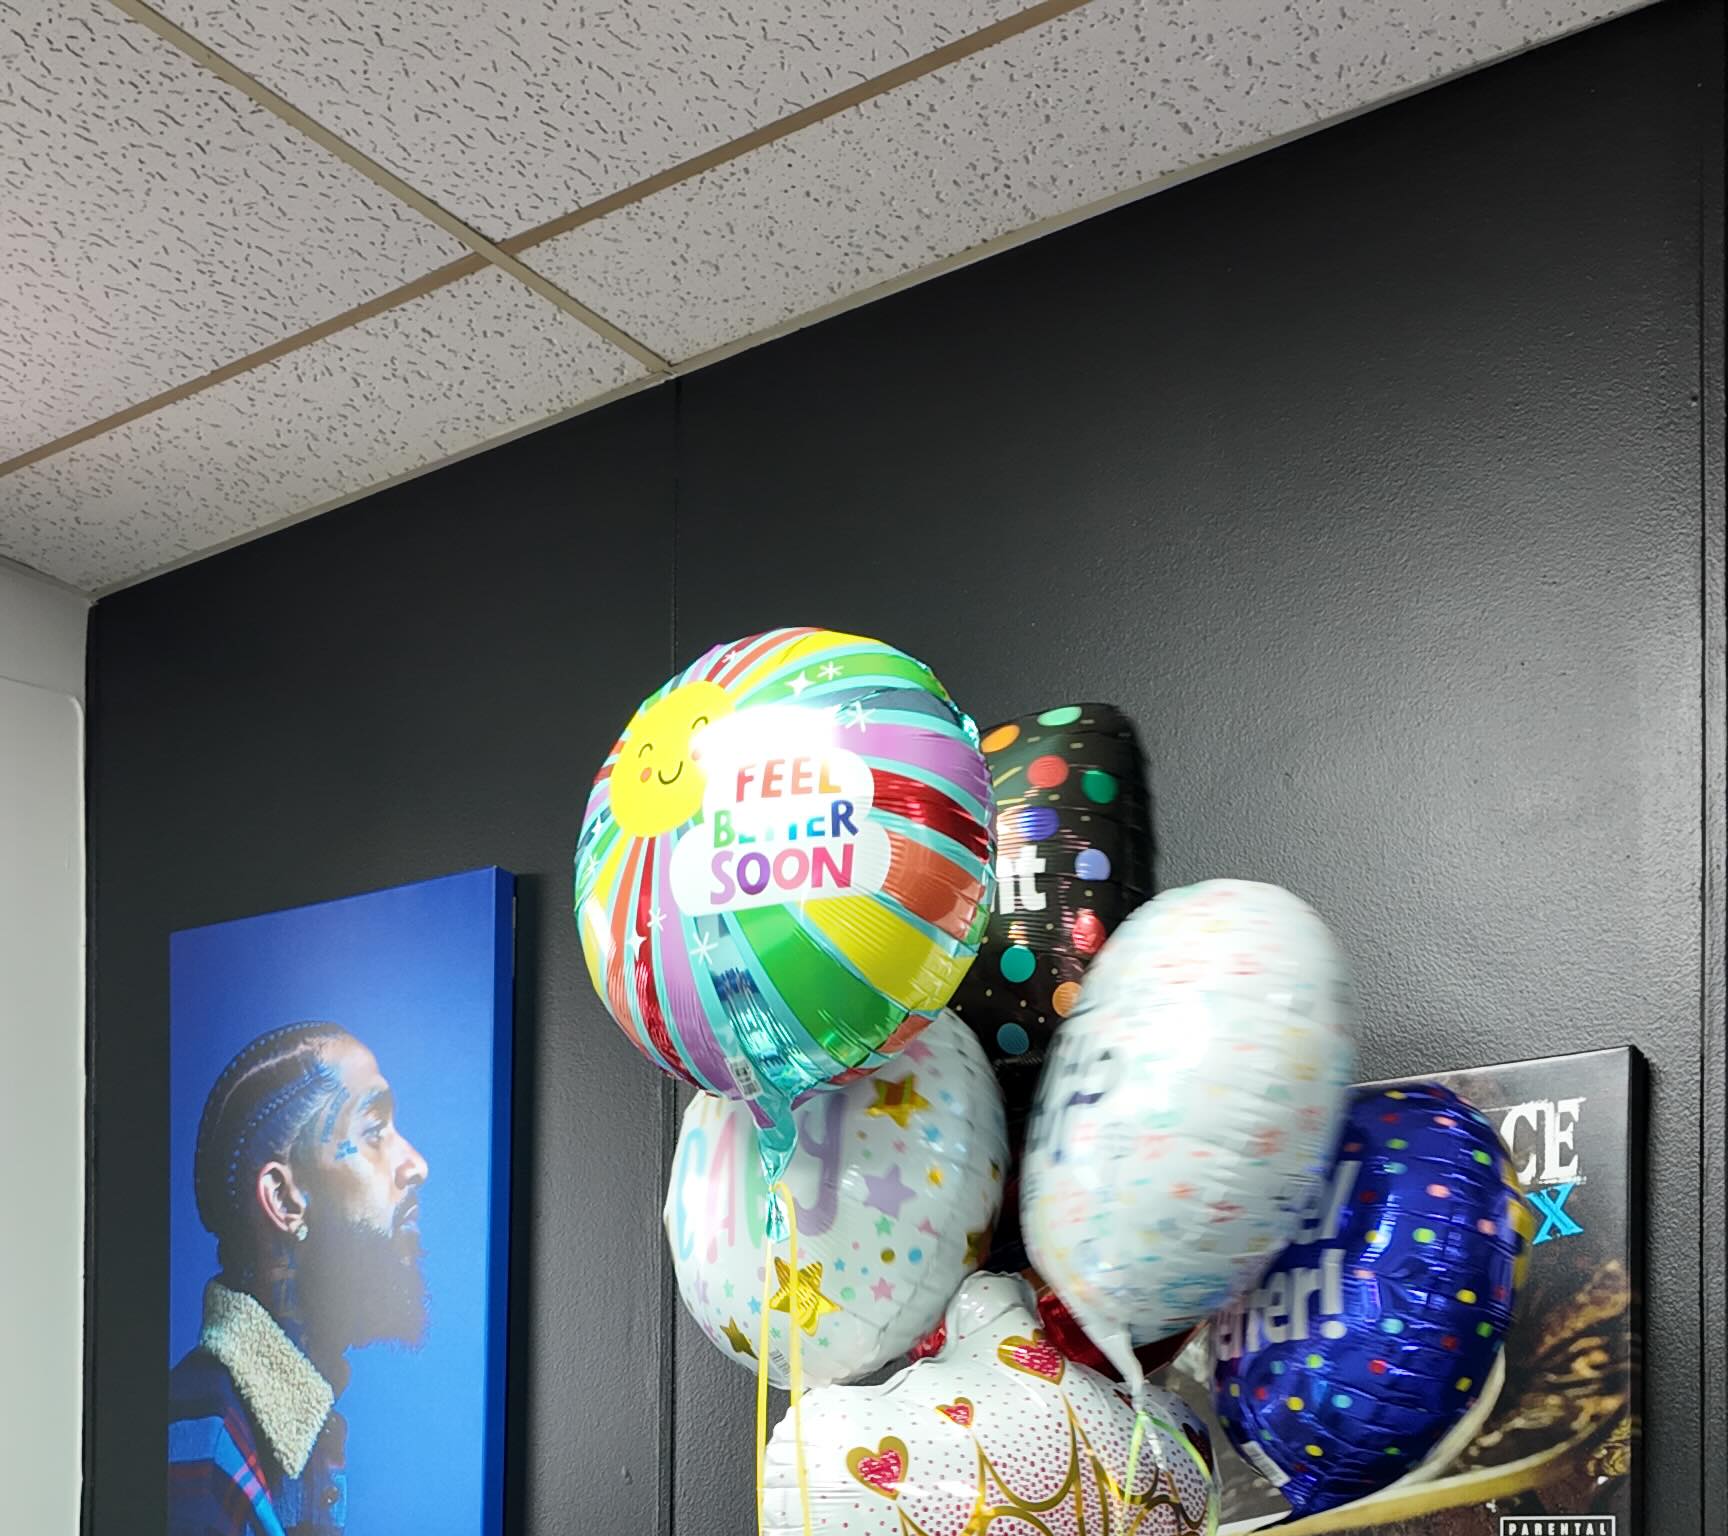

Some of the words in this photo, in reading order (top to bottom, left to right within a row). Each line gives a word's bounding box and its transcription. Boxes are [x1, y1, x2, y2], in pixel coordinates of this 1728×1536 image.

[735, 756, 842, 803] FEEL
[710, 843, 854, 905] SOON
[1508, 1522, 1607, 1536] PARENTAL
